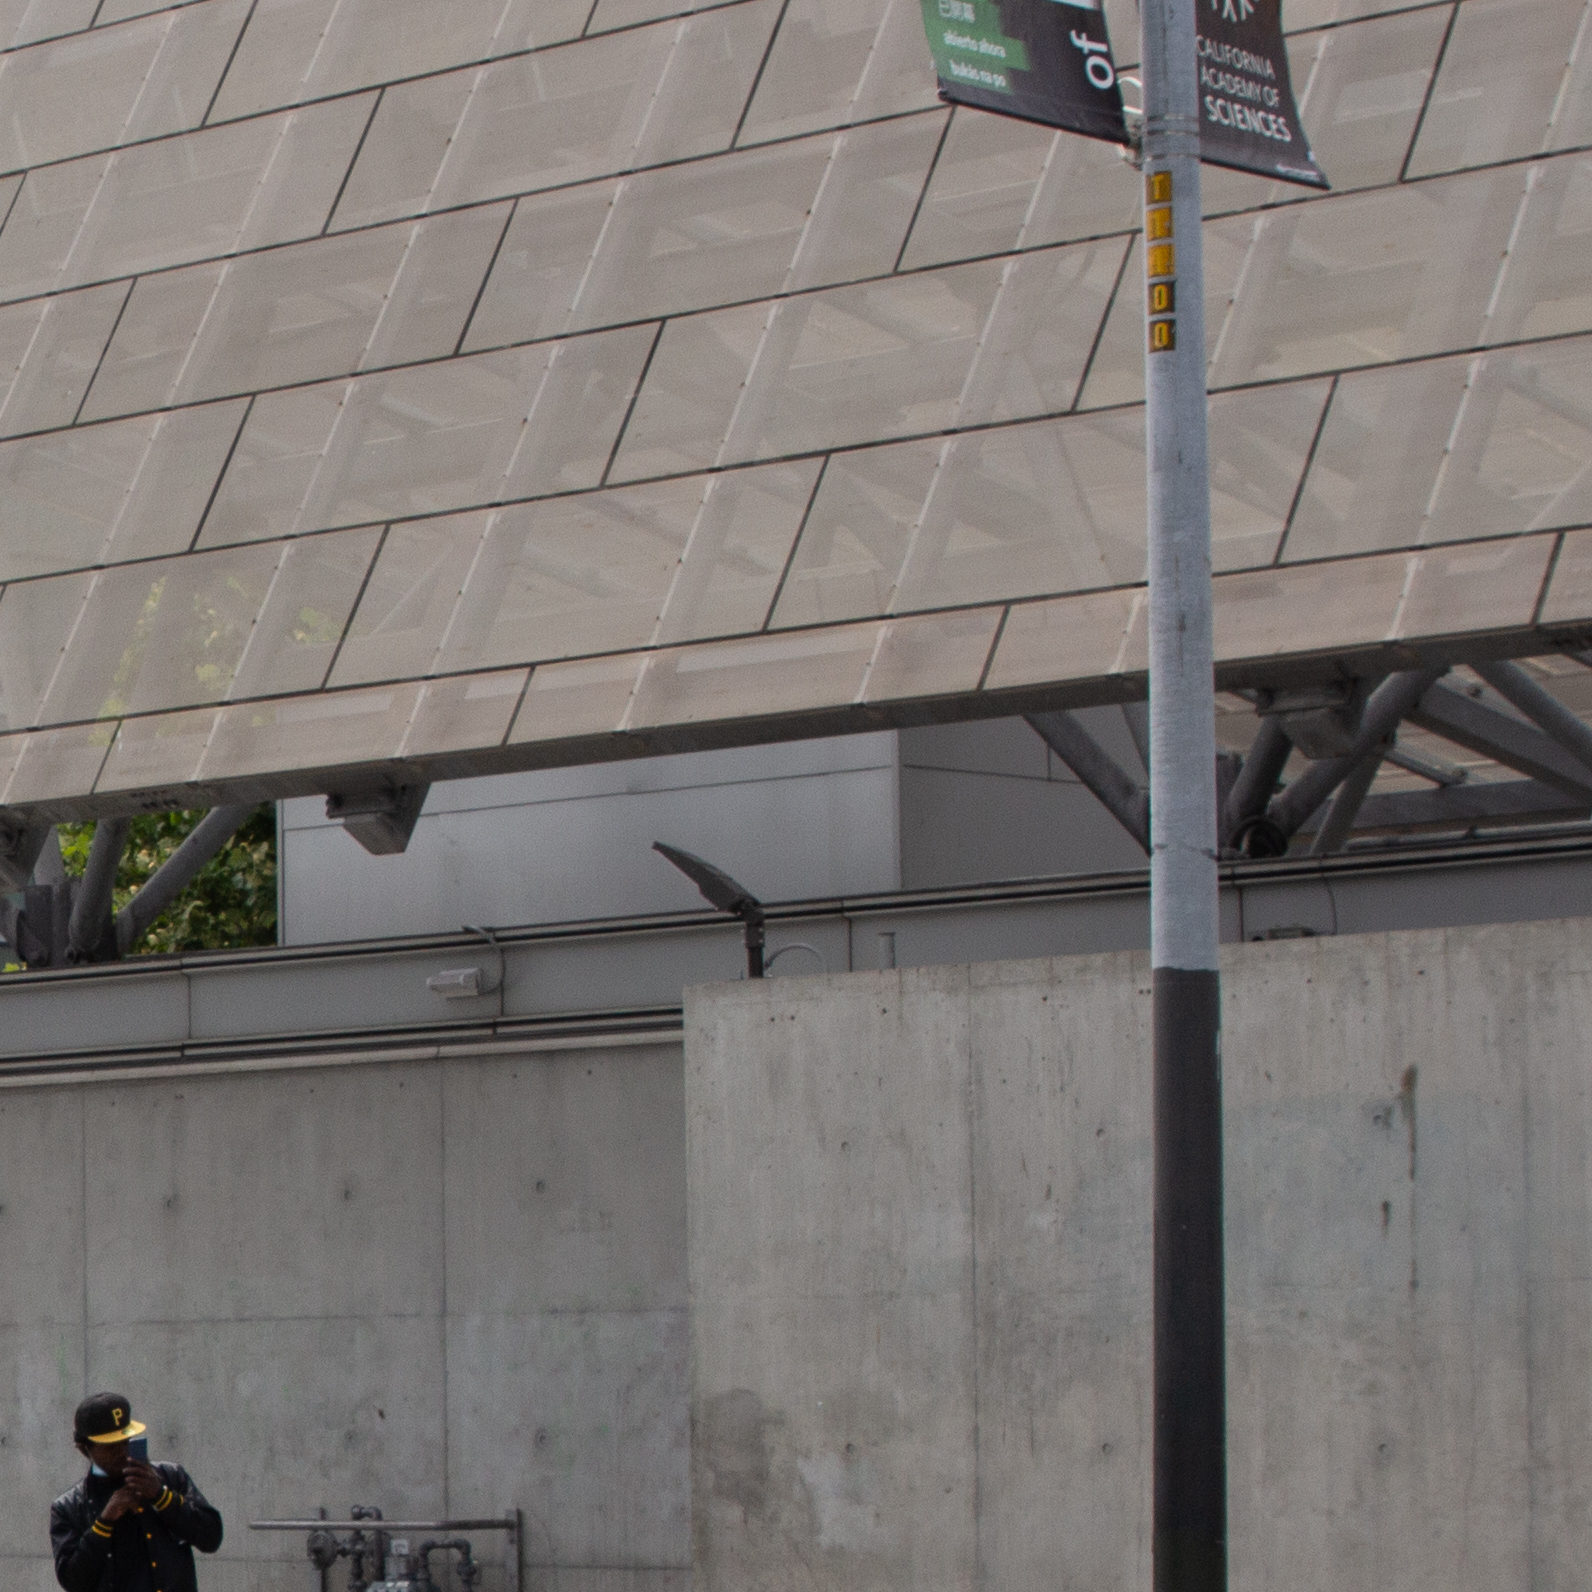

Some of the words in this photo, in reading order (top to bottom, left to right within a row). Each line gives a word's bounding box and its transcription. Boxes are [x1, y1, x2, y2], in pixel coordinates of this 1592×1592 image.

[1070, 29, 1115, 90] of
[1196, 35, 1276, 80] CALIFORNIA
[1200, 64, 1262, 103] ACADEMY
[1262, 85, 1280, 109] OF
[1204, 95, 1292, 142] SCIENCES
[112, 1407, 124, 1427] P
